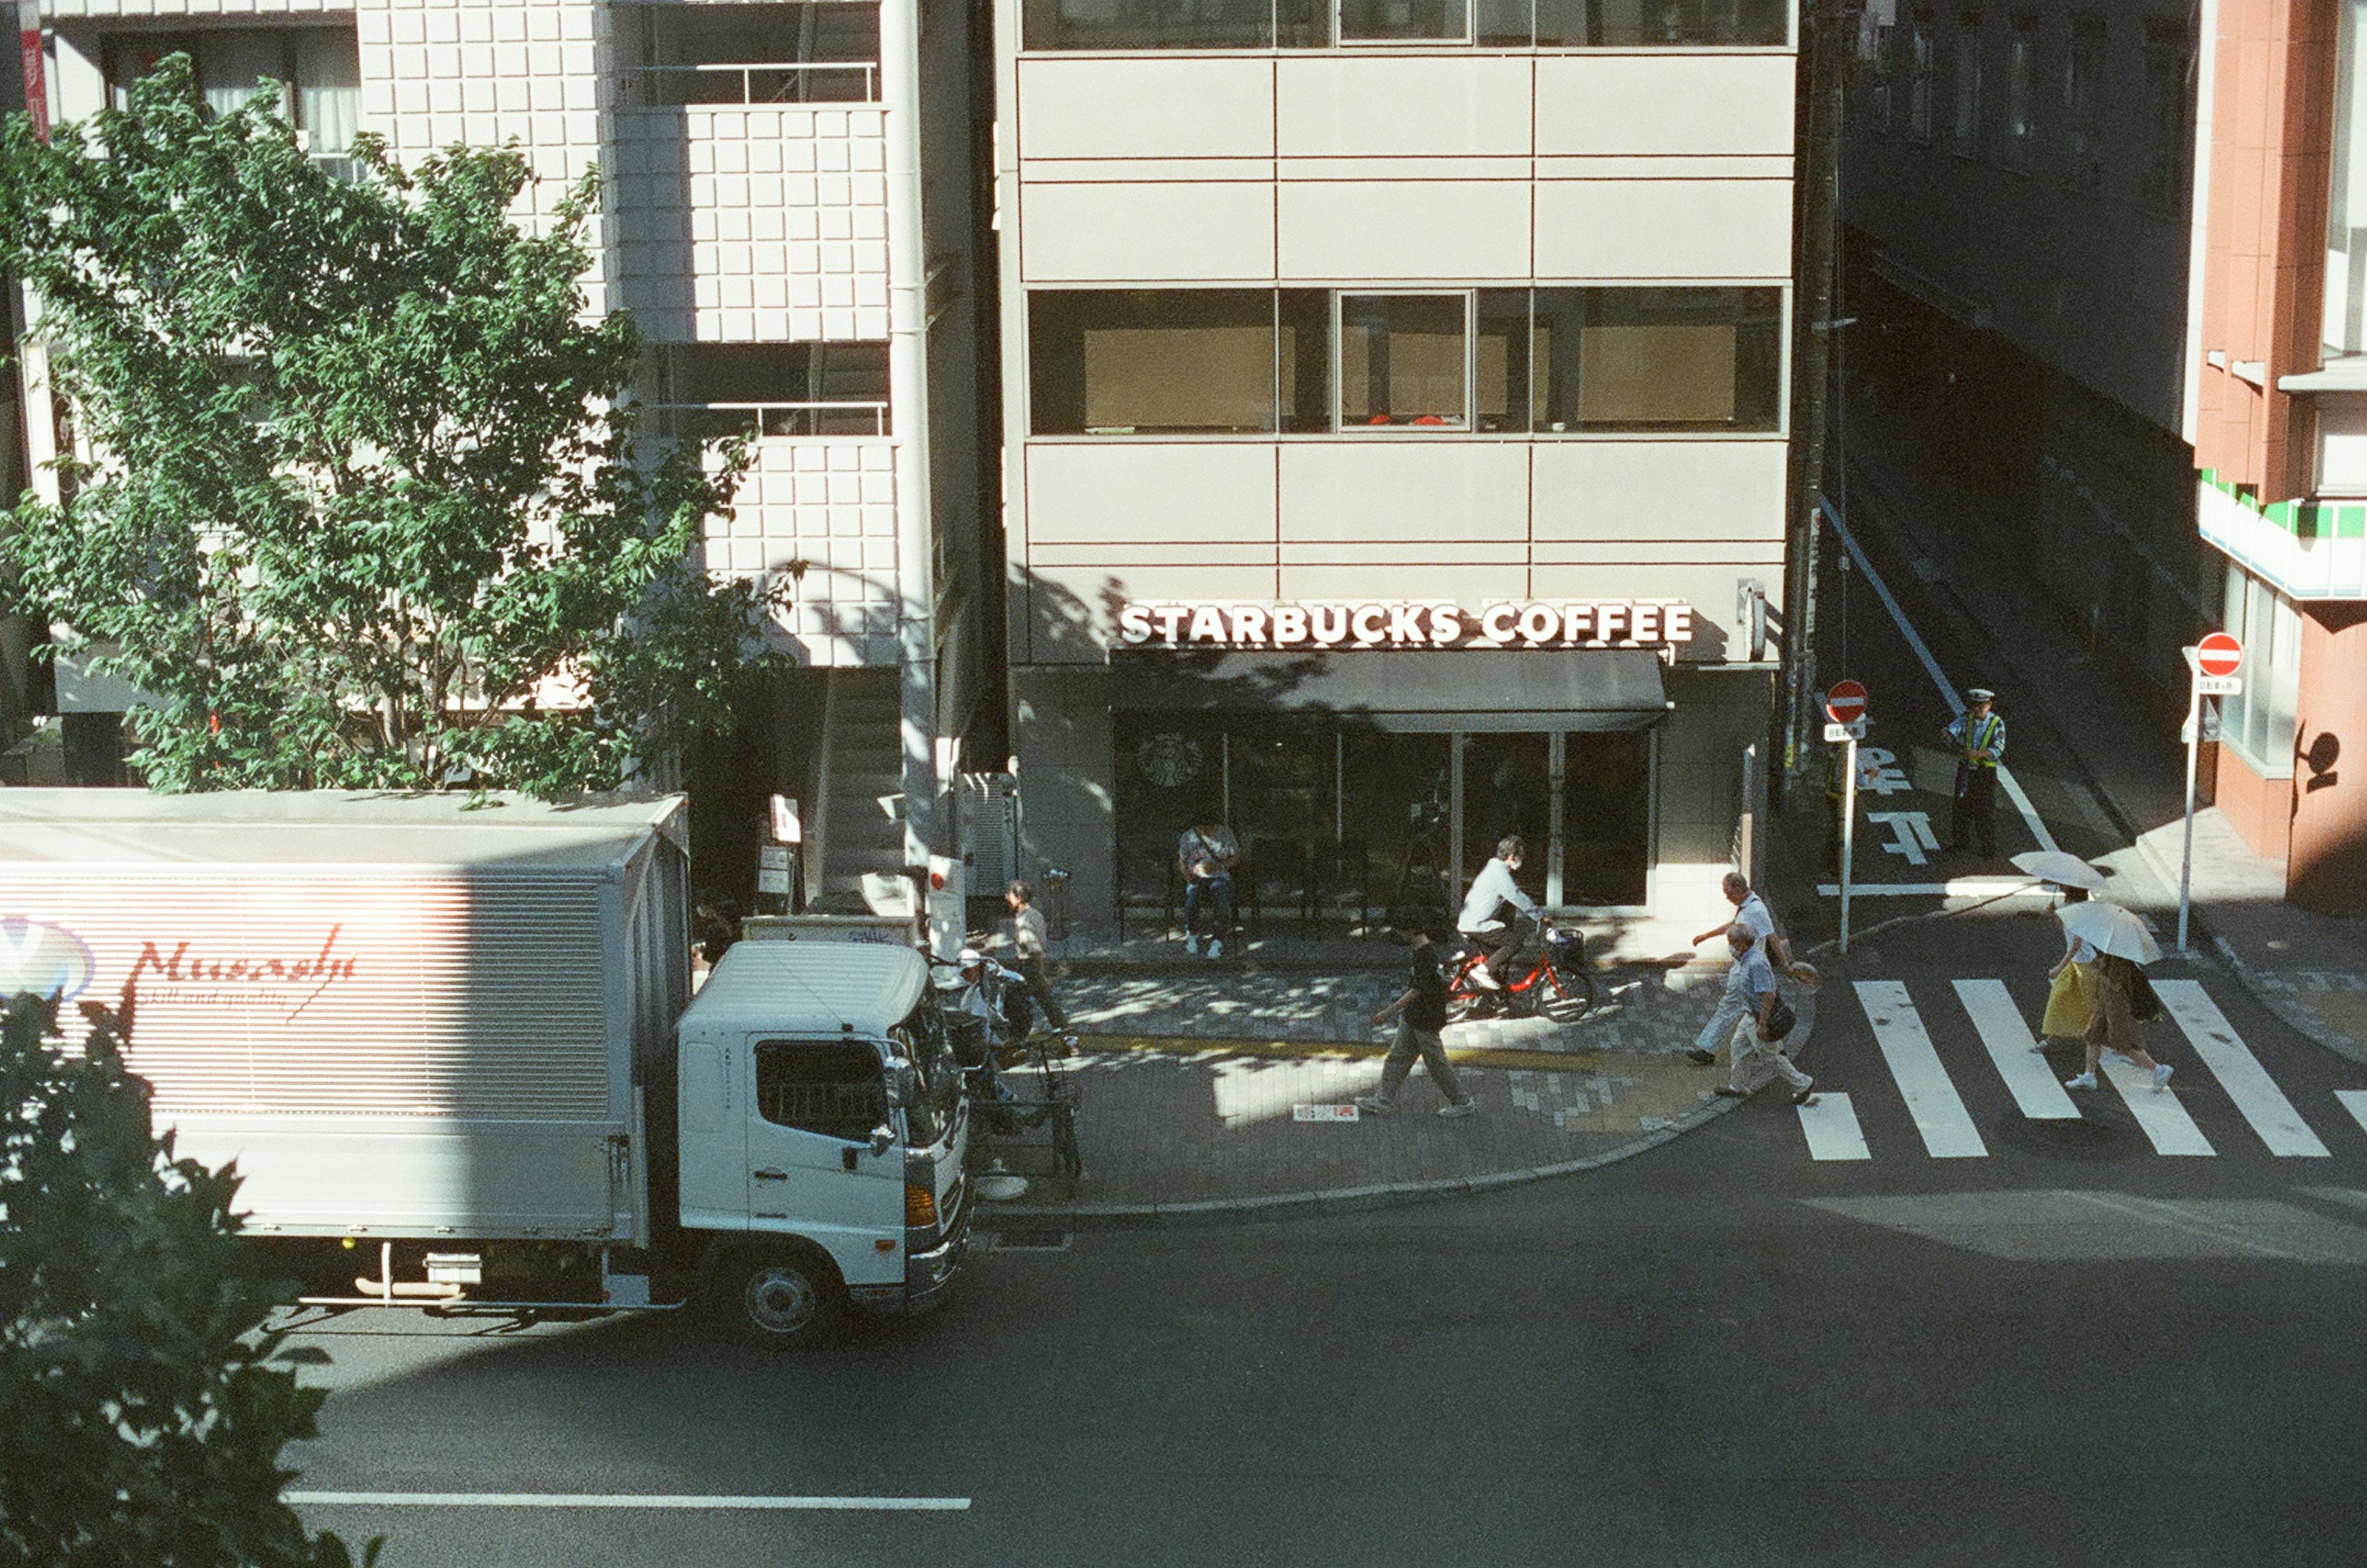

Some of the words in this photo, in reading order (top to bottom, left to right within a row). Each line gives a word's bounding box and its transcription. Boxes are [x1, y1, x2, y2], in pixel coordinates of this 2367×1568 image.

[1120, 604, 1461, 642] STARBUCKS
[1482, 604, 1693, 642] COFFEE
[121, 923, 358, 1024] Musashi
[136, 988, 179, 1005] Skill
[184, 988, 219, 1004] and
[223, 988, 287, 1009] quality
